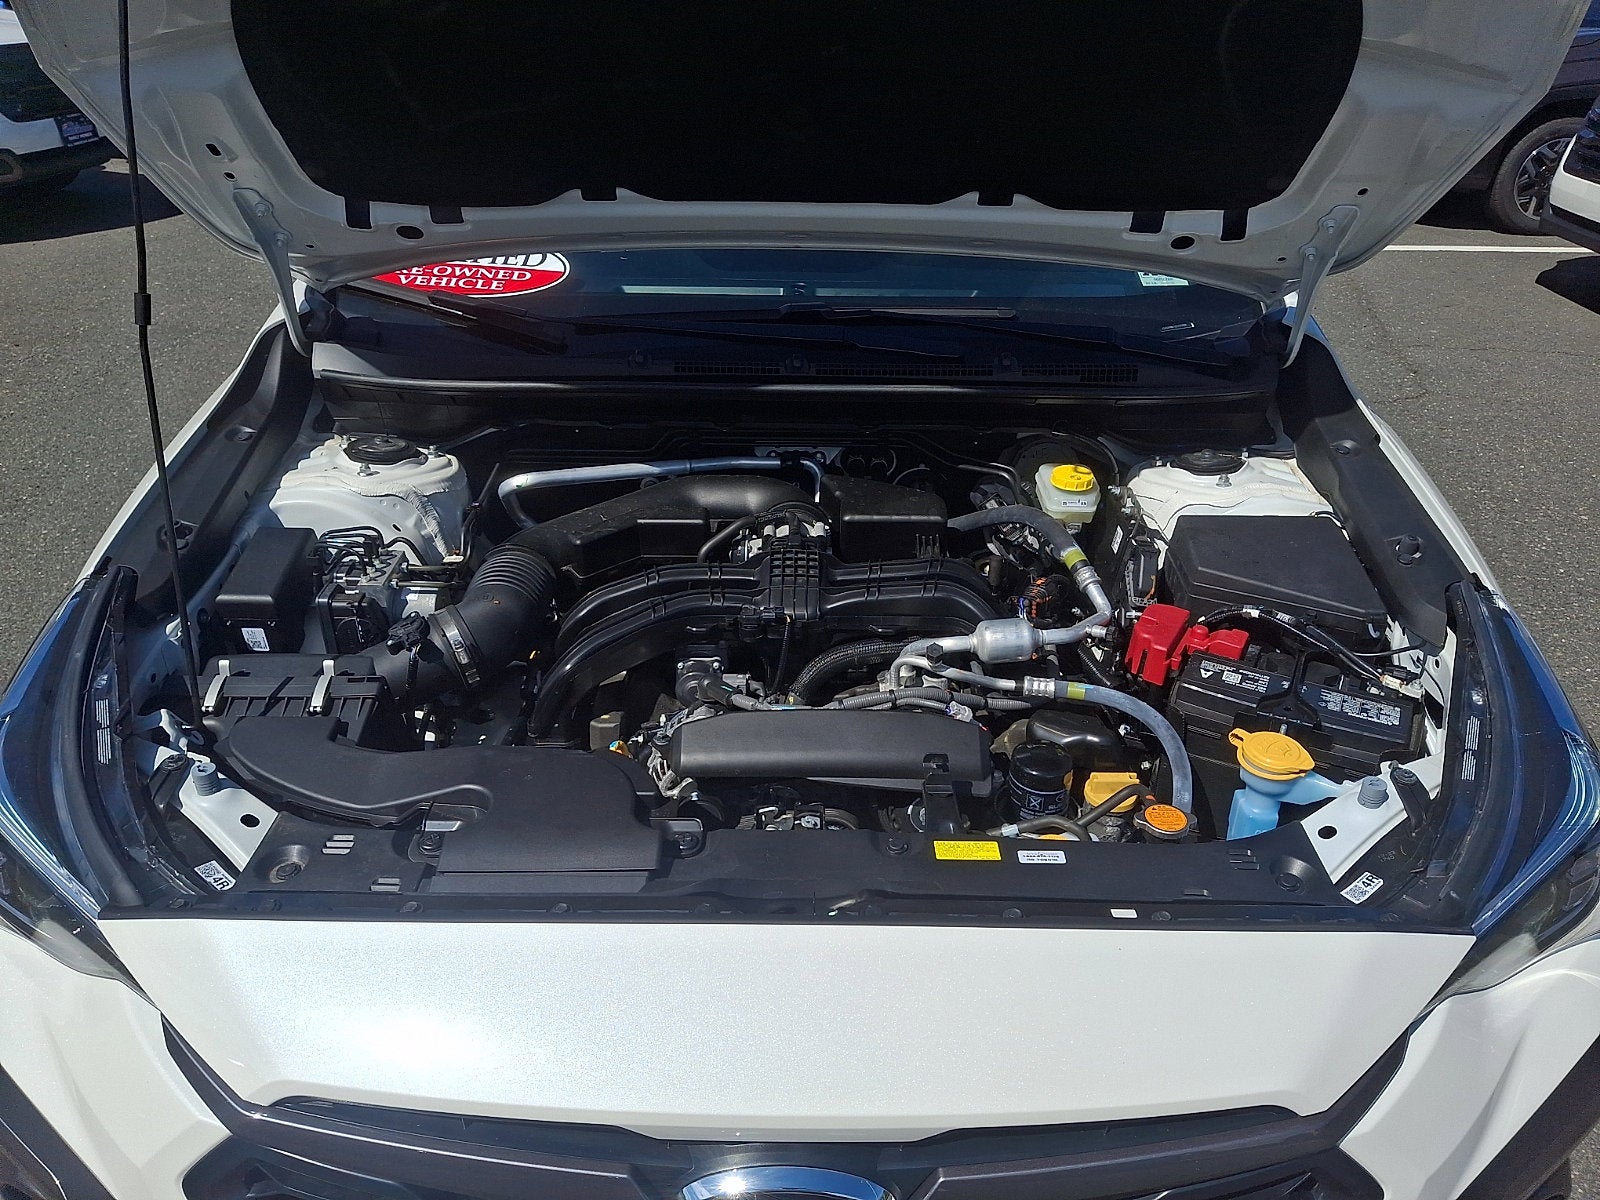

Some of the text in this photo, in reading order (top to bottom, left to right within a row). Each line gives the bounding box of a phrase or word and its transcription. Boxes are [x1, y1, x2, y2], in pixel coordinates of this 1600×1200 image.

[394, 265, 532, 281] E-OWNED
[397, 274, 504, 291] VEHICLE
[212, 877, 230, 890] 4R
[1362, 875, 1379, 888] 4R
